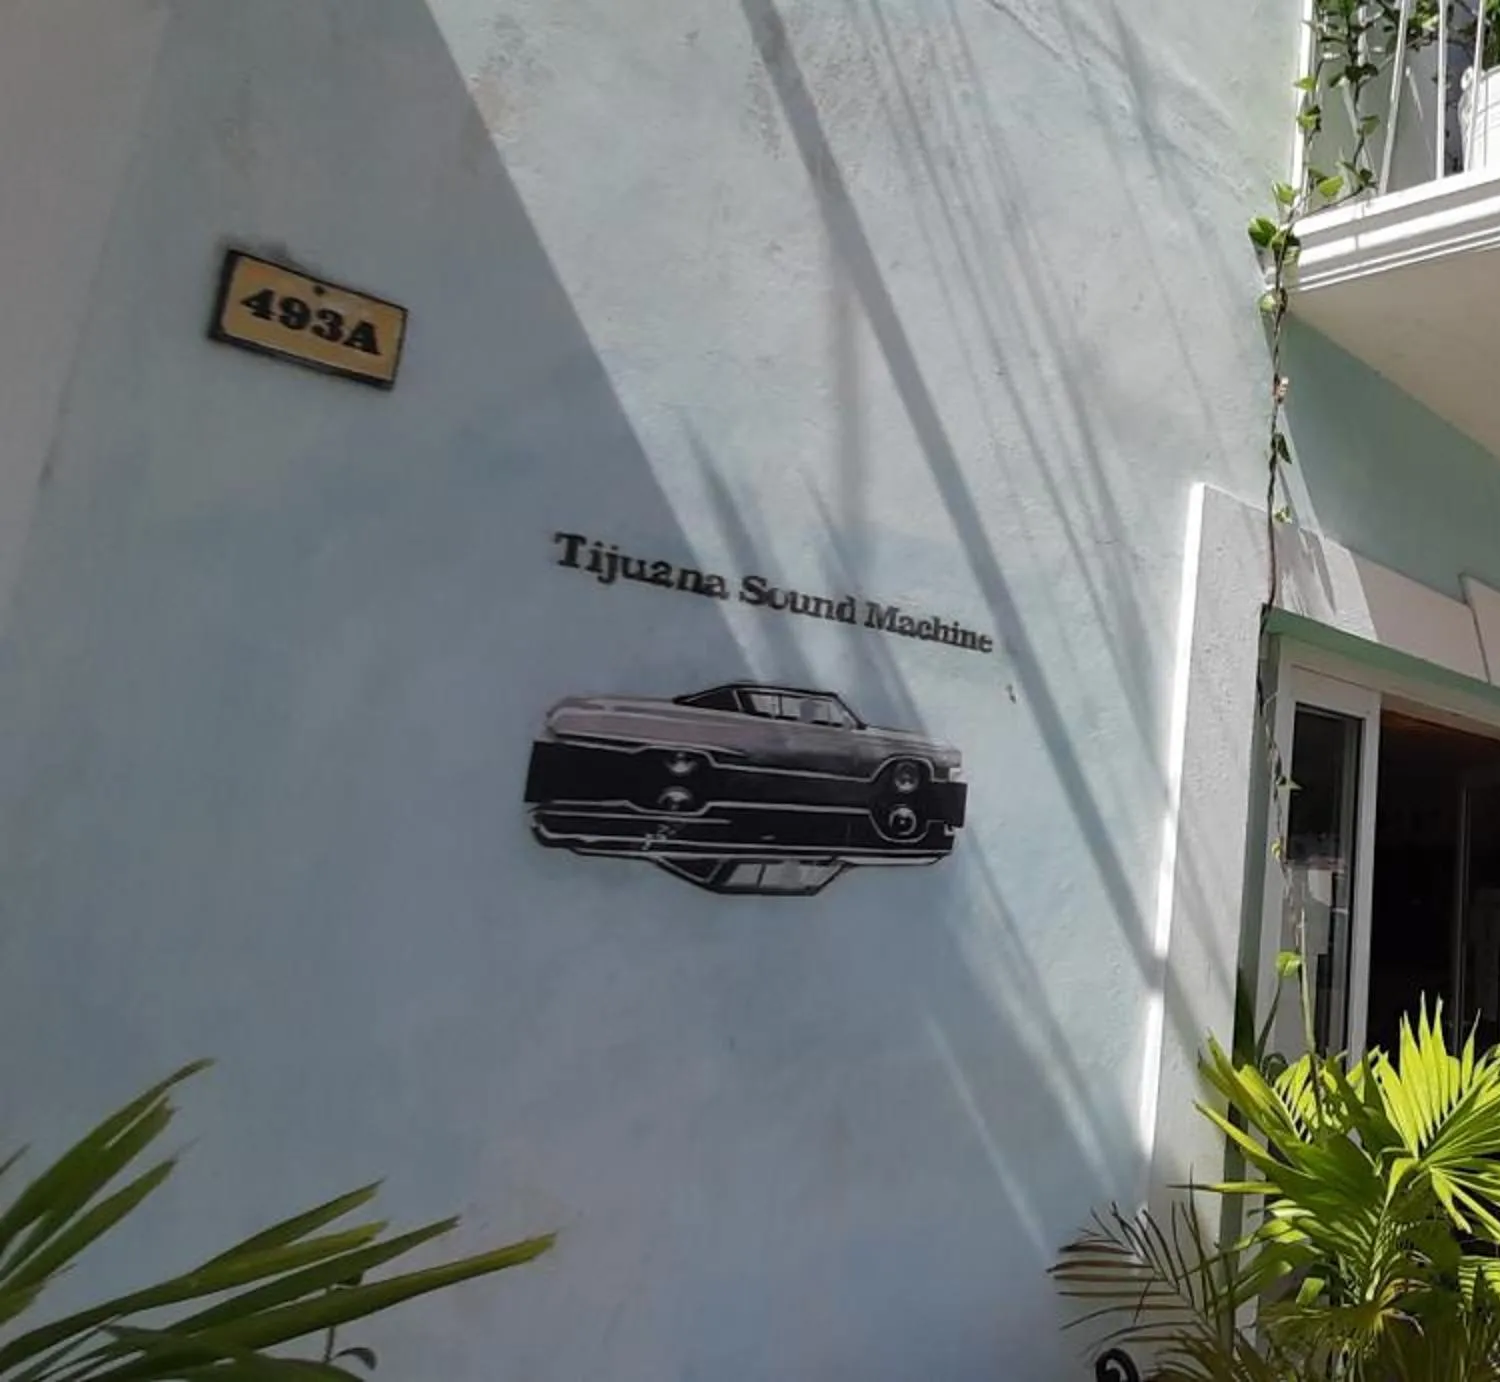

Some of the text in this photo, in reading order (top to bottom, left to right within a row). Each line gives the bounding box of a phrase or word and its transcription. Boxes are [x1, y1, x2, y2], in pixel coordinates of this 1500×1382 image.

[239, 287, 383, 356] 493A
[554, 532, 994, 654] Tijuana Sound Machine
